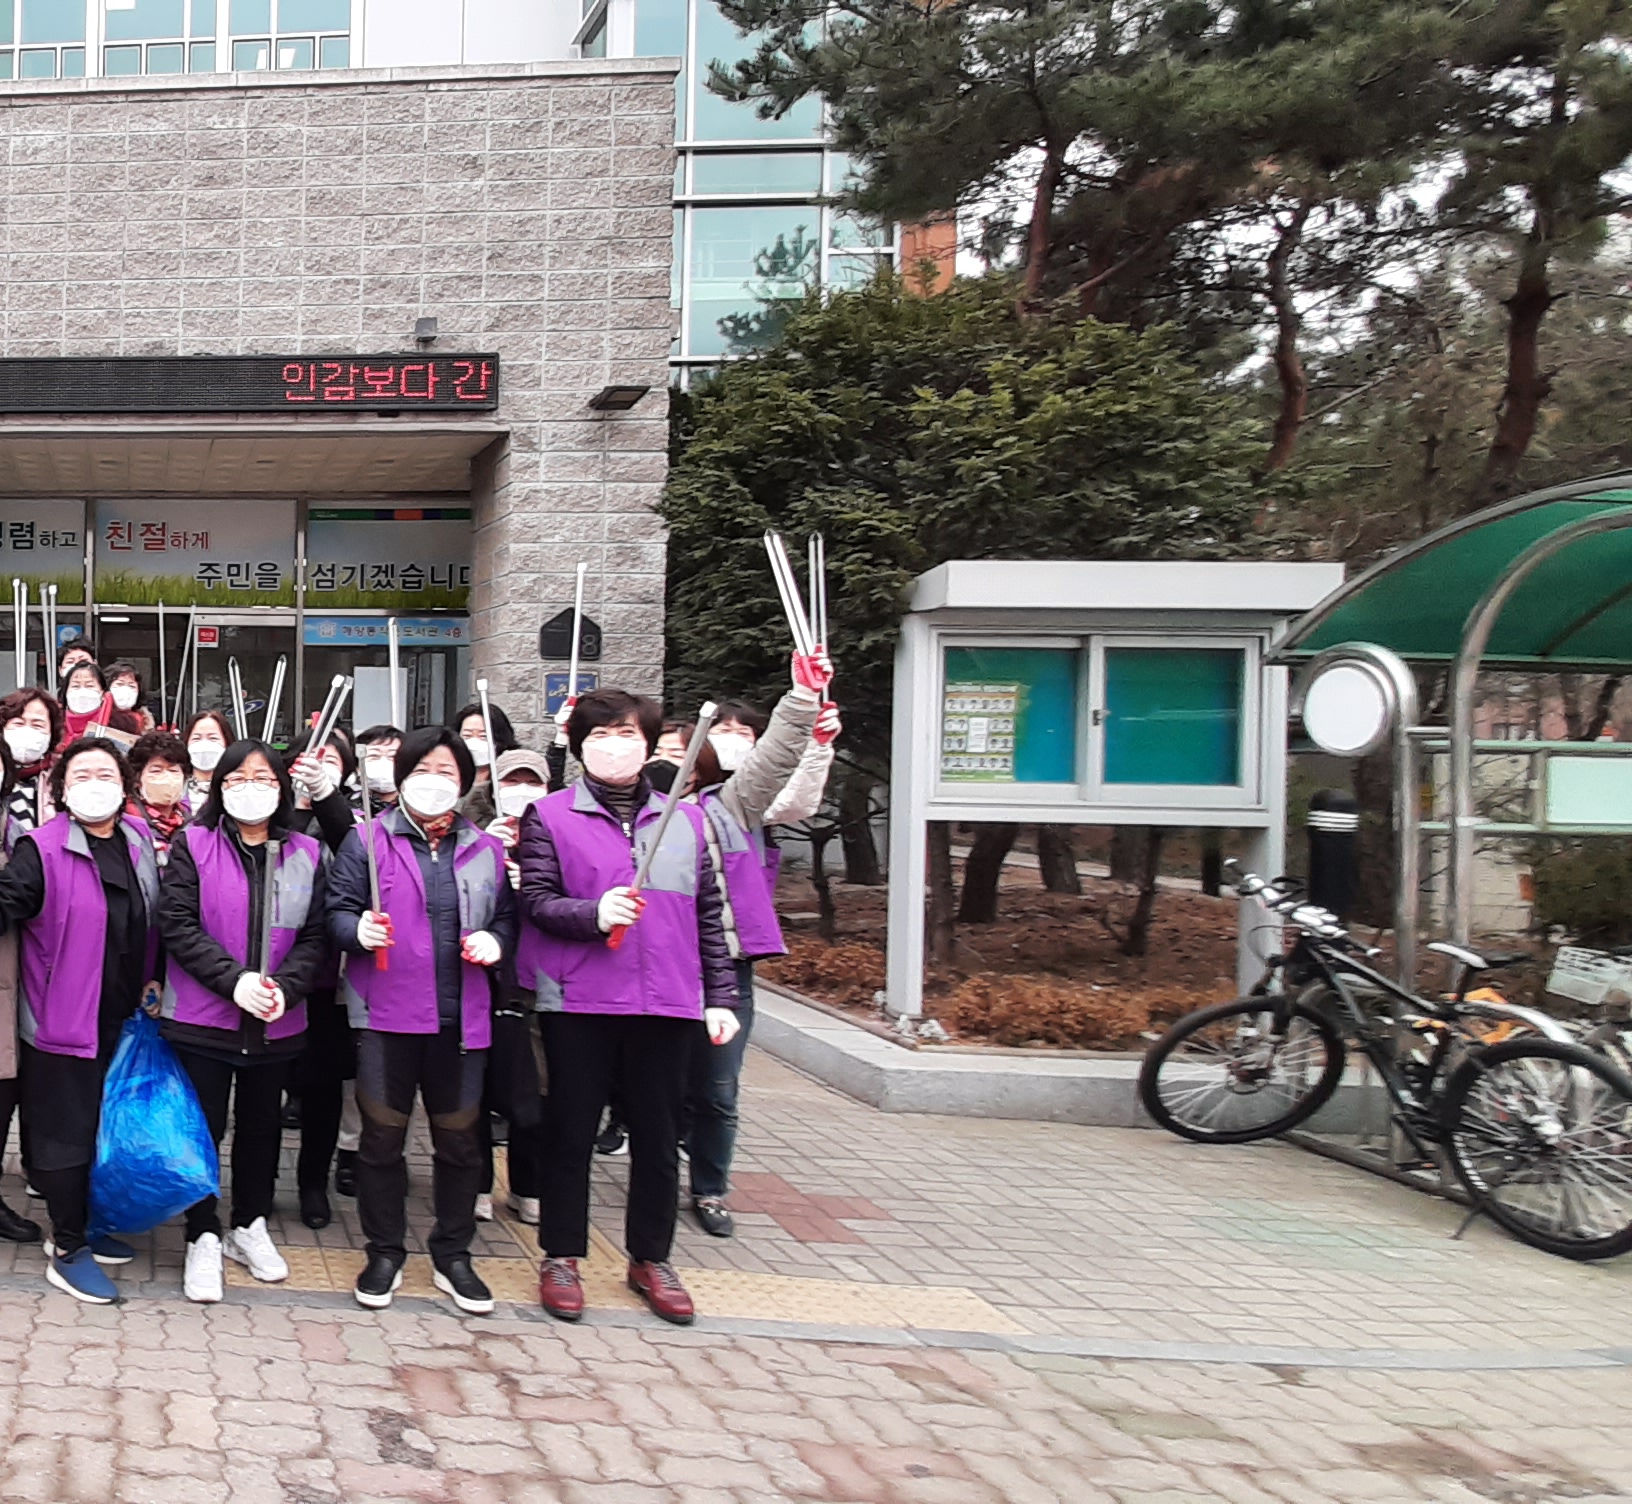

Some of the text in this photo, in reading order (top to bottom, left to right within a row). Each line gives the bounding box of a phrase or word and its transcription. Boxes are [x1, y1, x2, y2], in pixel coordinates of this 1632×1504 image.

[282, 360, 493, 401] 인감보다 간
[105, 520, 210, 551] 친절하게
[196, 561, 282, 590] 주민을
[380, 626, 439, 637] 작도서관
